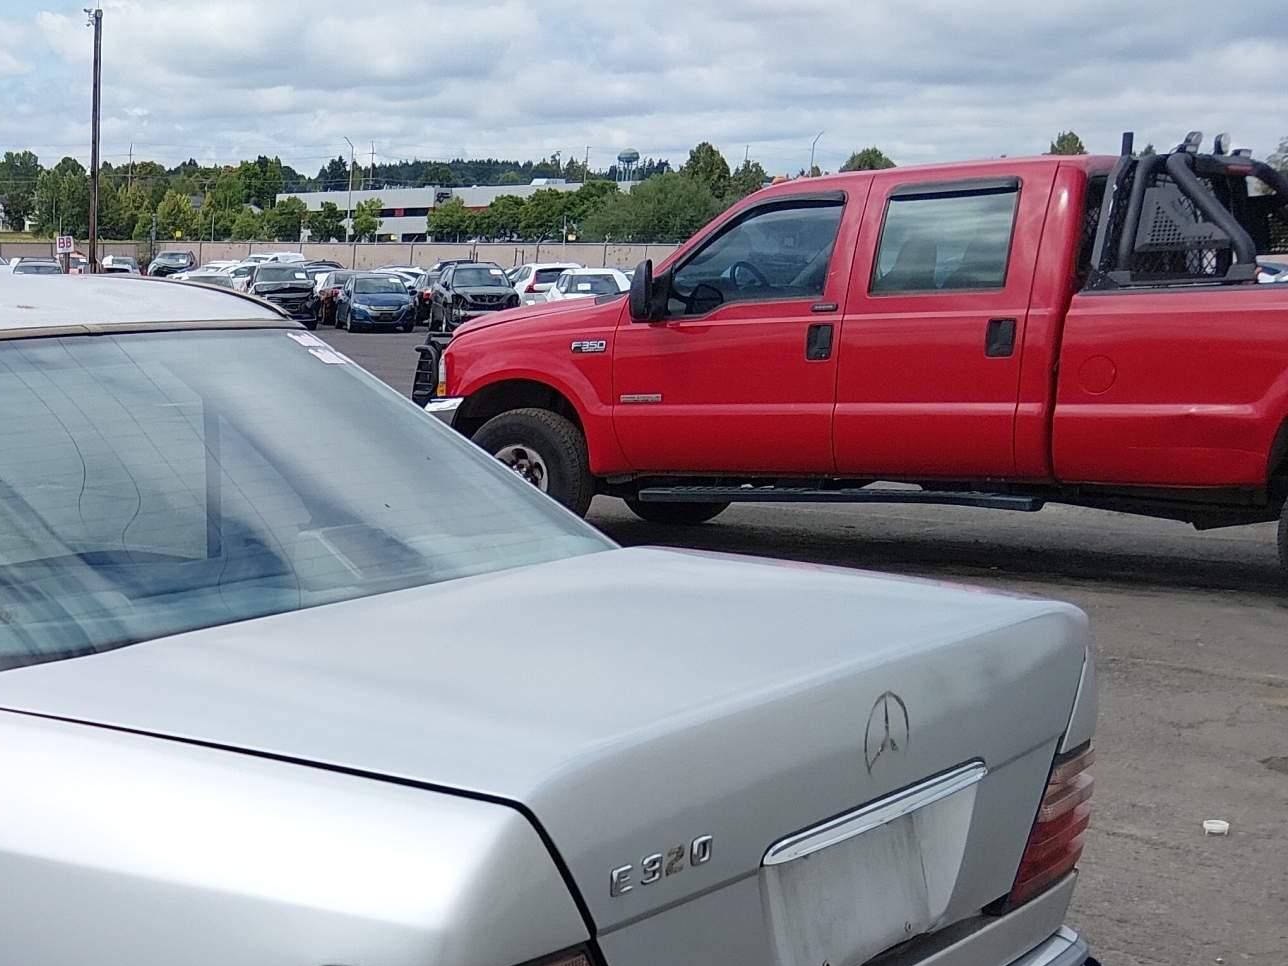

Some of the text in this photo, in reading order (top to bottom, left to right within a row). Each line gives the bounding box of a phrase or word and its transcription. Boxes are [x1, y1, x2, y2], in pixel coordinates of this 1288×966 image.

[58, 237, 72, 248] BB
[610, 834, 713, 897] E 320
